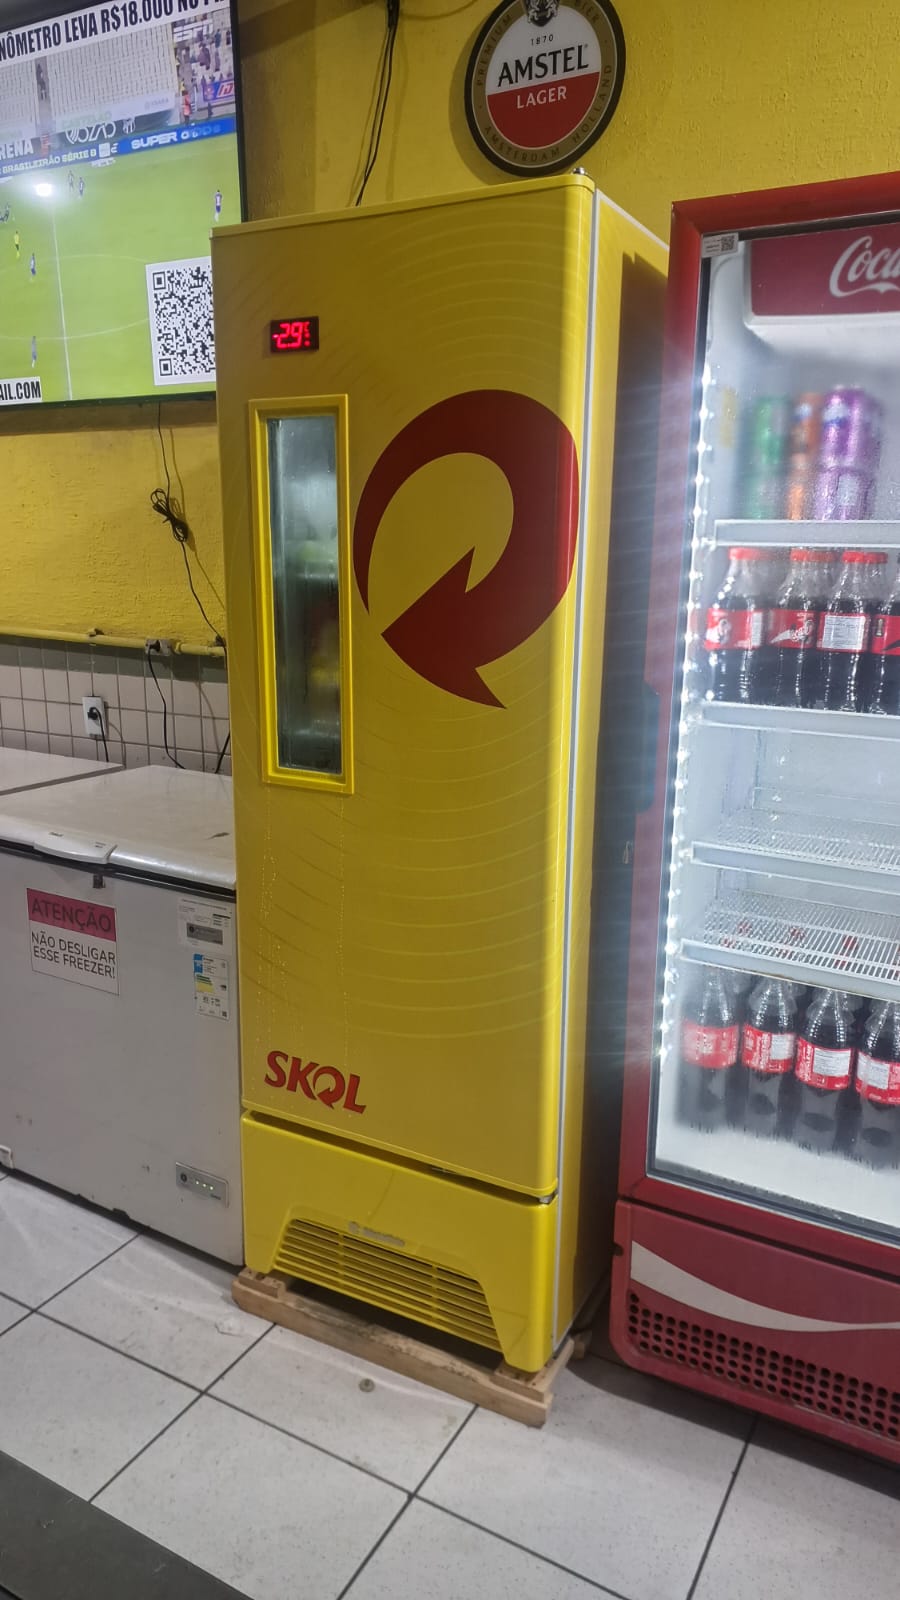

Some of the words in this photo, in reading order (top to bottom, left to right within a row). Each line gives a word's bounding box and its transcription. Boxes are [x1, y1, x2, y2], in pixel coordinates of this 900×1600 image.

[64, 12, 98, 43] LEVA
[101, 0, 173, 34] R$18.000
[477, 14, 514, 86] PREMIUM
[530, 34, 554, 46] 1870
[497, 44, 590, 88] AMSTEL
[483, 125, 560, 162] AMSTERDAM
[573, 64, 612, 143] HOLLAND
[516, 86, 567, 109] LAGER
[131, 131, 178, 150] SUPER
[32, 898, 112, 932] ATENÇÃO
[31, 930, 56, 948] NÃO
[59, 938, 116, 965] DESLIGAR
[33, 945, 60, 964] ESSE
[63, 953, 116, 979] FREEZER!
[264, 1050, 367, 1115] SKOL
